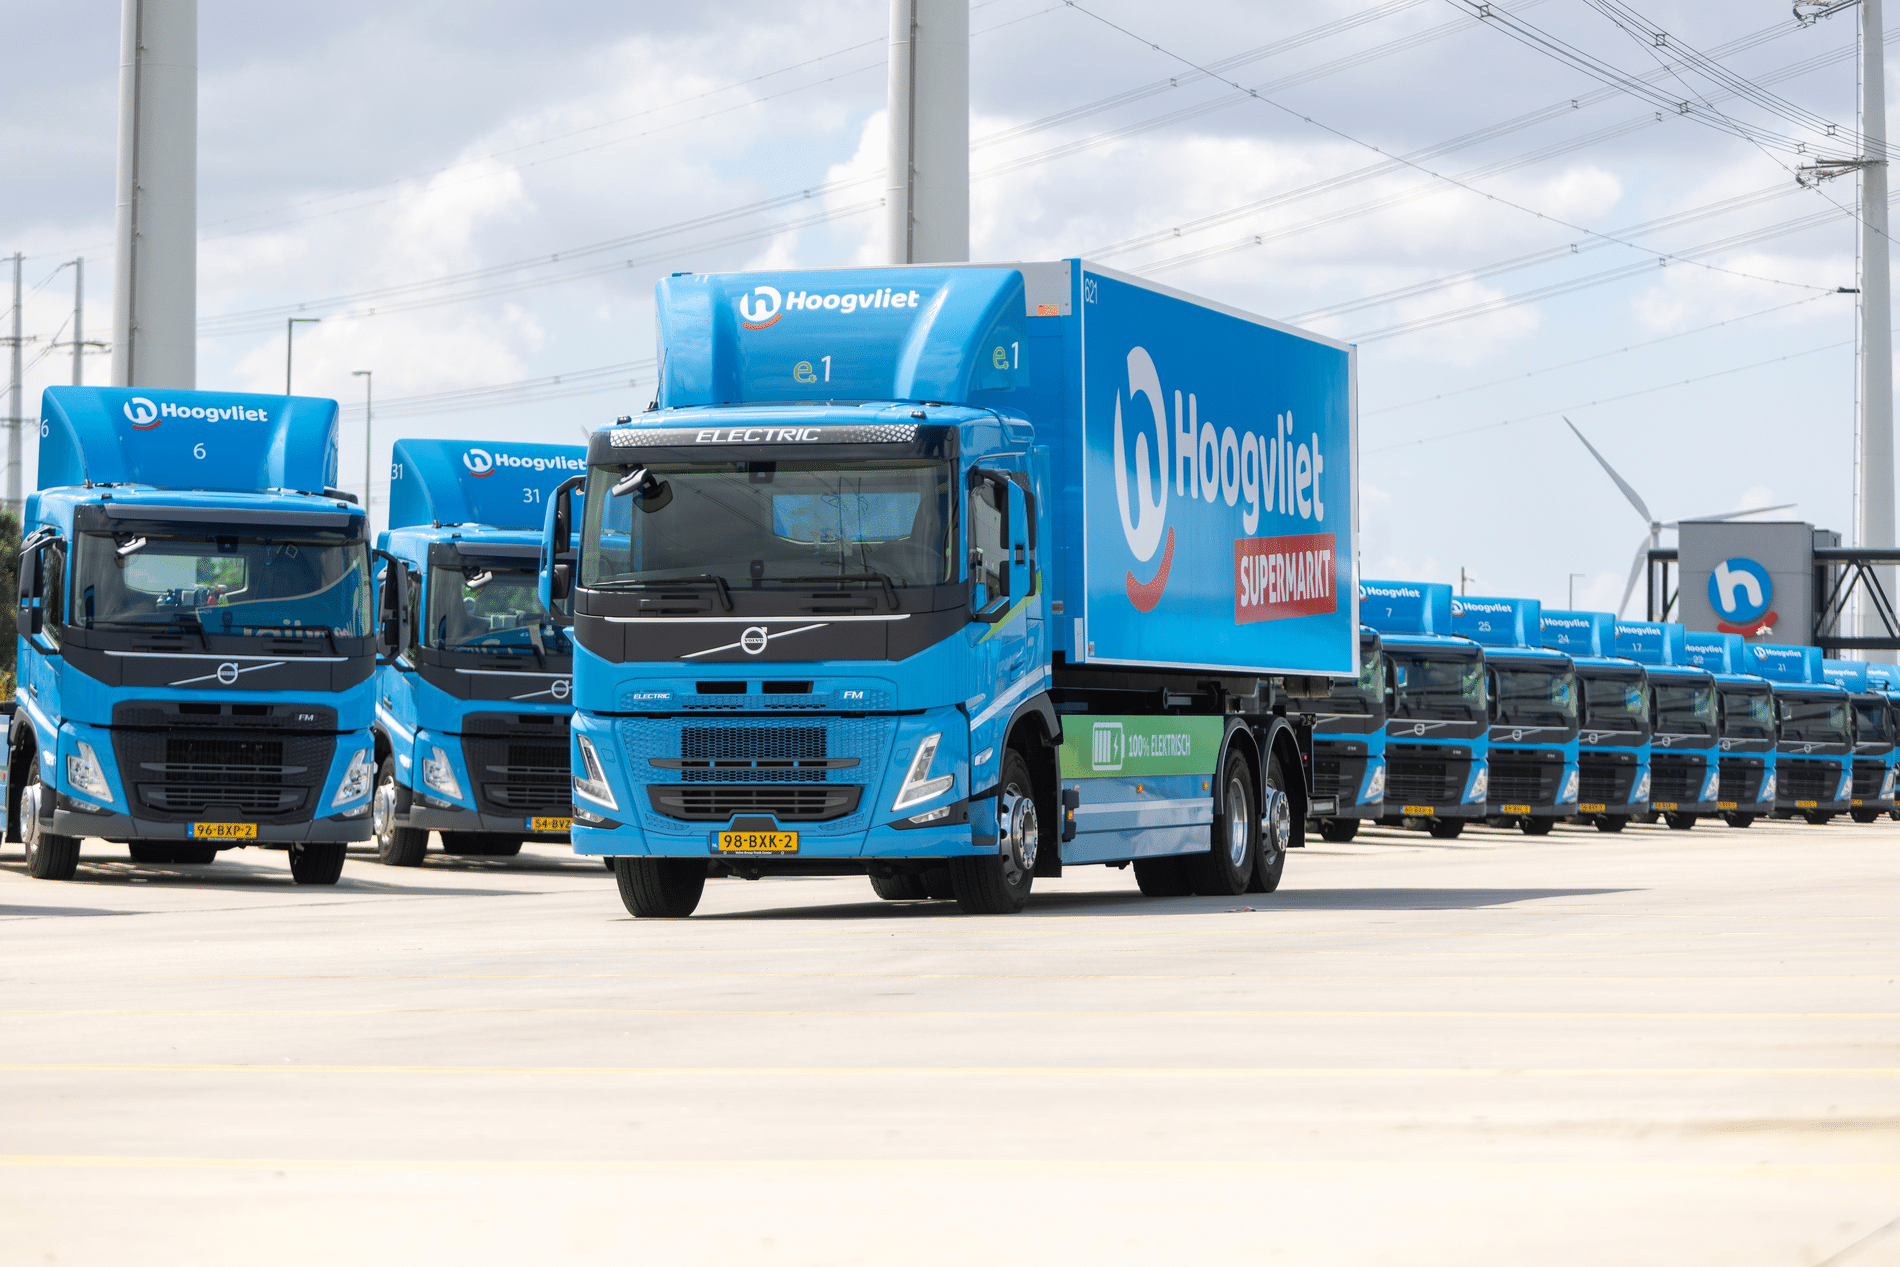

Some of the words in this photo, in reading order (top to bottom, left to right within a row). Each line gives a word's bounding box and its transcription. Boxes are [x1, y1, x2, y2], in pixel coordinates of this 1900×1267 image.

[1084, 277, 1099, 305] 621
[785, 289, 919, 314] Hoogvliet
[161, 403, 268, 423] Hoogvliet
[41, 418, 49, 438] 6
[695, 427, 821, 442] ELECTRIC
[193, 443, 206, 460] 6
[495, 454, 586, 471] Hoogvliet
[1175, 389, 1324, 535] Hoogvliet
[391, 463, 403, 480] 31
[522, 488, 540, 503] 31
[1240, 549, 1331, 607] SUPERMARKT
[1366, 586, 1421, 598] Hoogvliet
[1386, 607, 1393, 618] 7
[1463, 602, 1513, 614] Hoogvliet
[1478, 621, 1492, 632] 25
[1544, 617, 1590, 629] Hoogvliet
[1619, 625, 1661, 637] Hoogvliet
[843, 691, 864, 700] FM
[298, 713, 315, 722] FM
[1128, 733, 1150, 757] 100%
[1151, 731, 1191, 758] ELEKTRISCH
[196, 824, 253, 837] 96-BXP-2
[724, 834, 792, 848] 98-BXK-2
